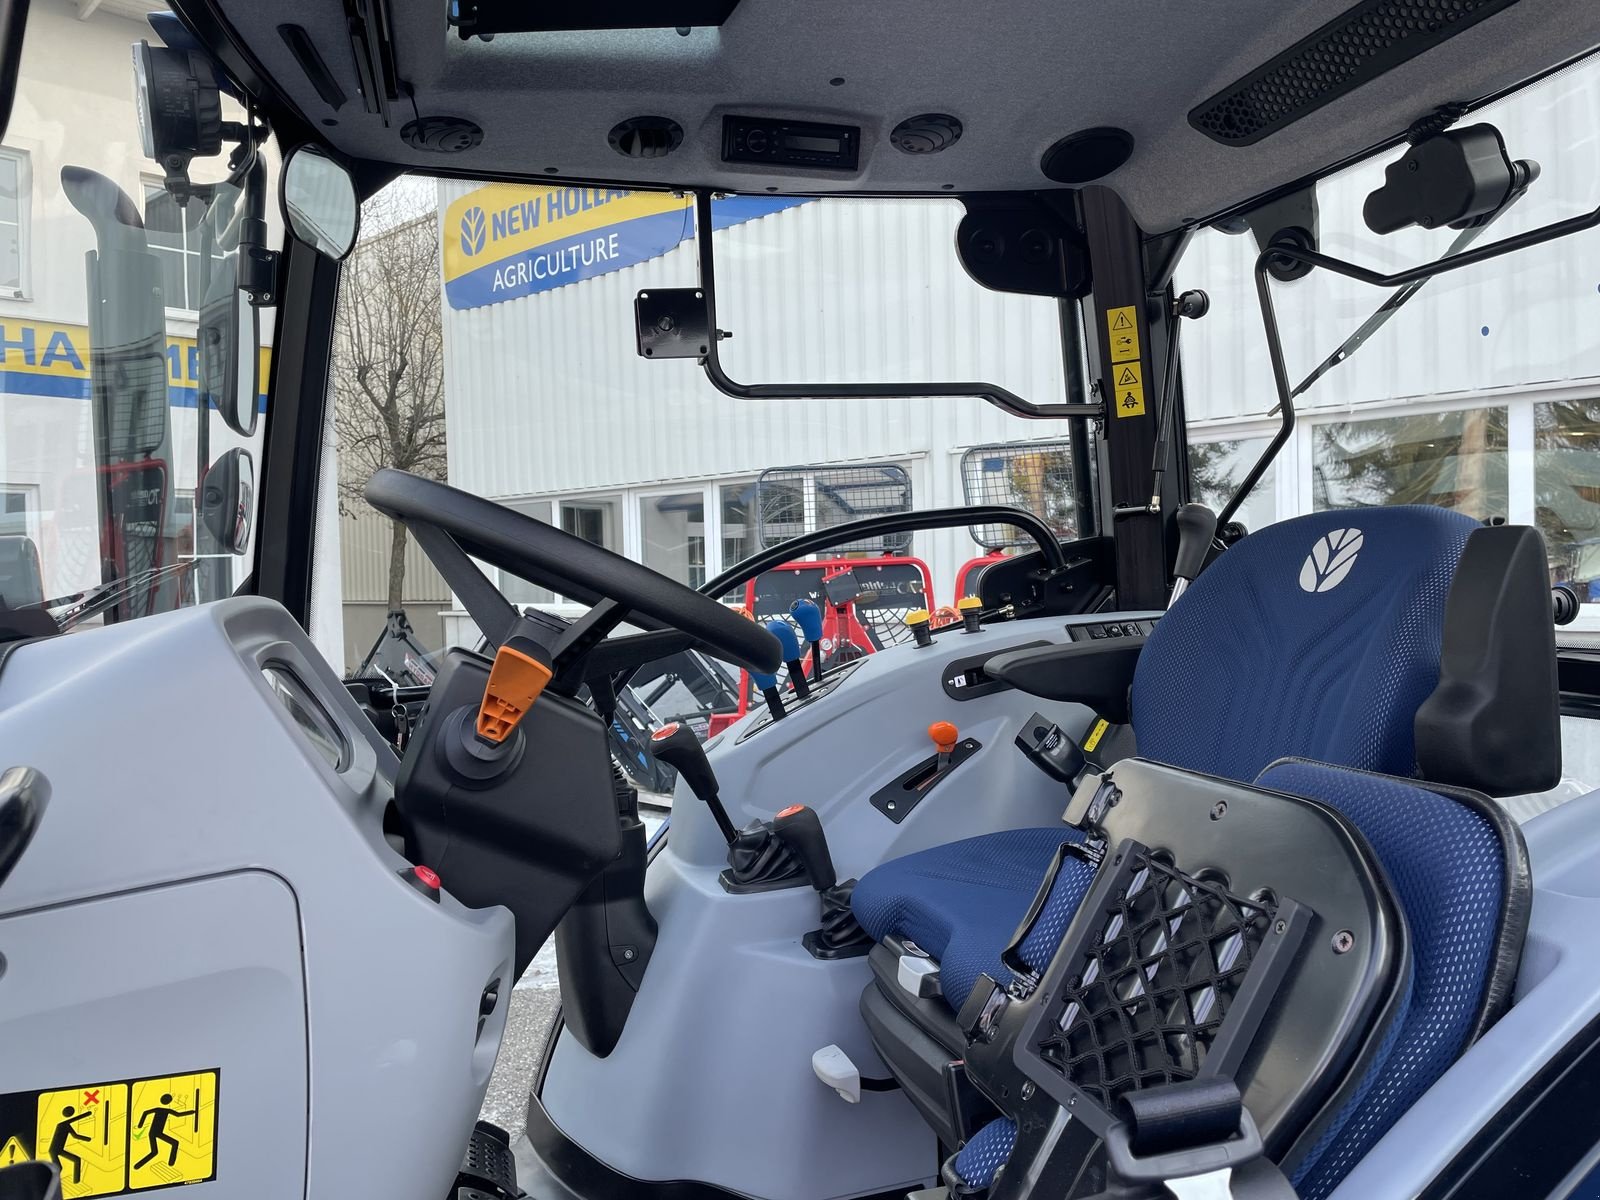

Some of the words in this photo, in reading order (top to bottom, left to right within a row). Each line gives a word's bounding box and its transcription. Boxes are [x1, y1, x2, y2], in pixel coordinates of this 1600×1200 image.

[492, 197, 541, 241] NEW
[547, 187, 631, 223] HOLLA
[492, 233, 620, 292] AGRICULTURE
